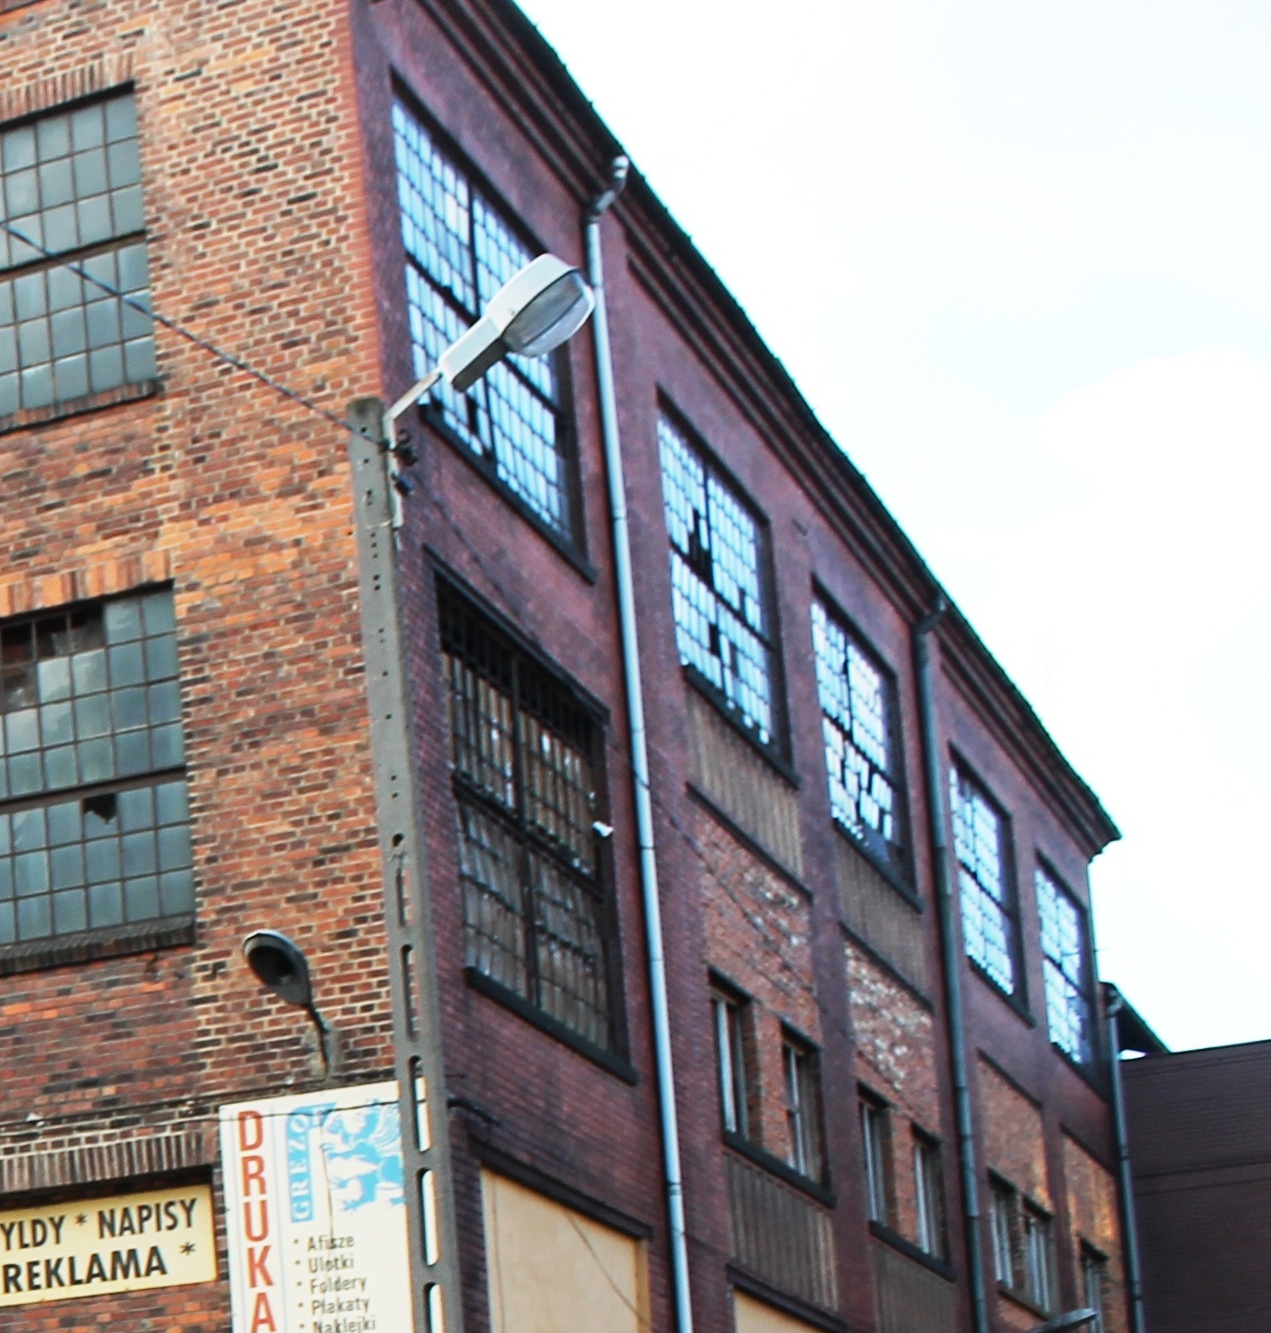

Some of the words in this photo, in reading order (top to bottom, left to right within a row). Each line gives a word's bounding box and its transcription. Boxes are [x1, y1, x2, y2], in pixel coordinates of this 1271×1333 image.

[97, 1197, 197, 1238] NAPISY
[307, 1234, 354, 1250] Afisze
[2, 1245, 167, 1293] REKLAMA
[308, 1252, 354, 1272] Ulotki
[309, 1275, 367, 1293] Foldery
[311, 1297, 369, 1314] Plakaty
